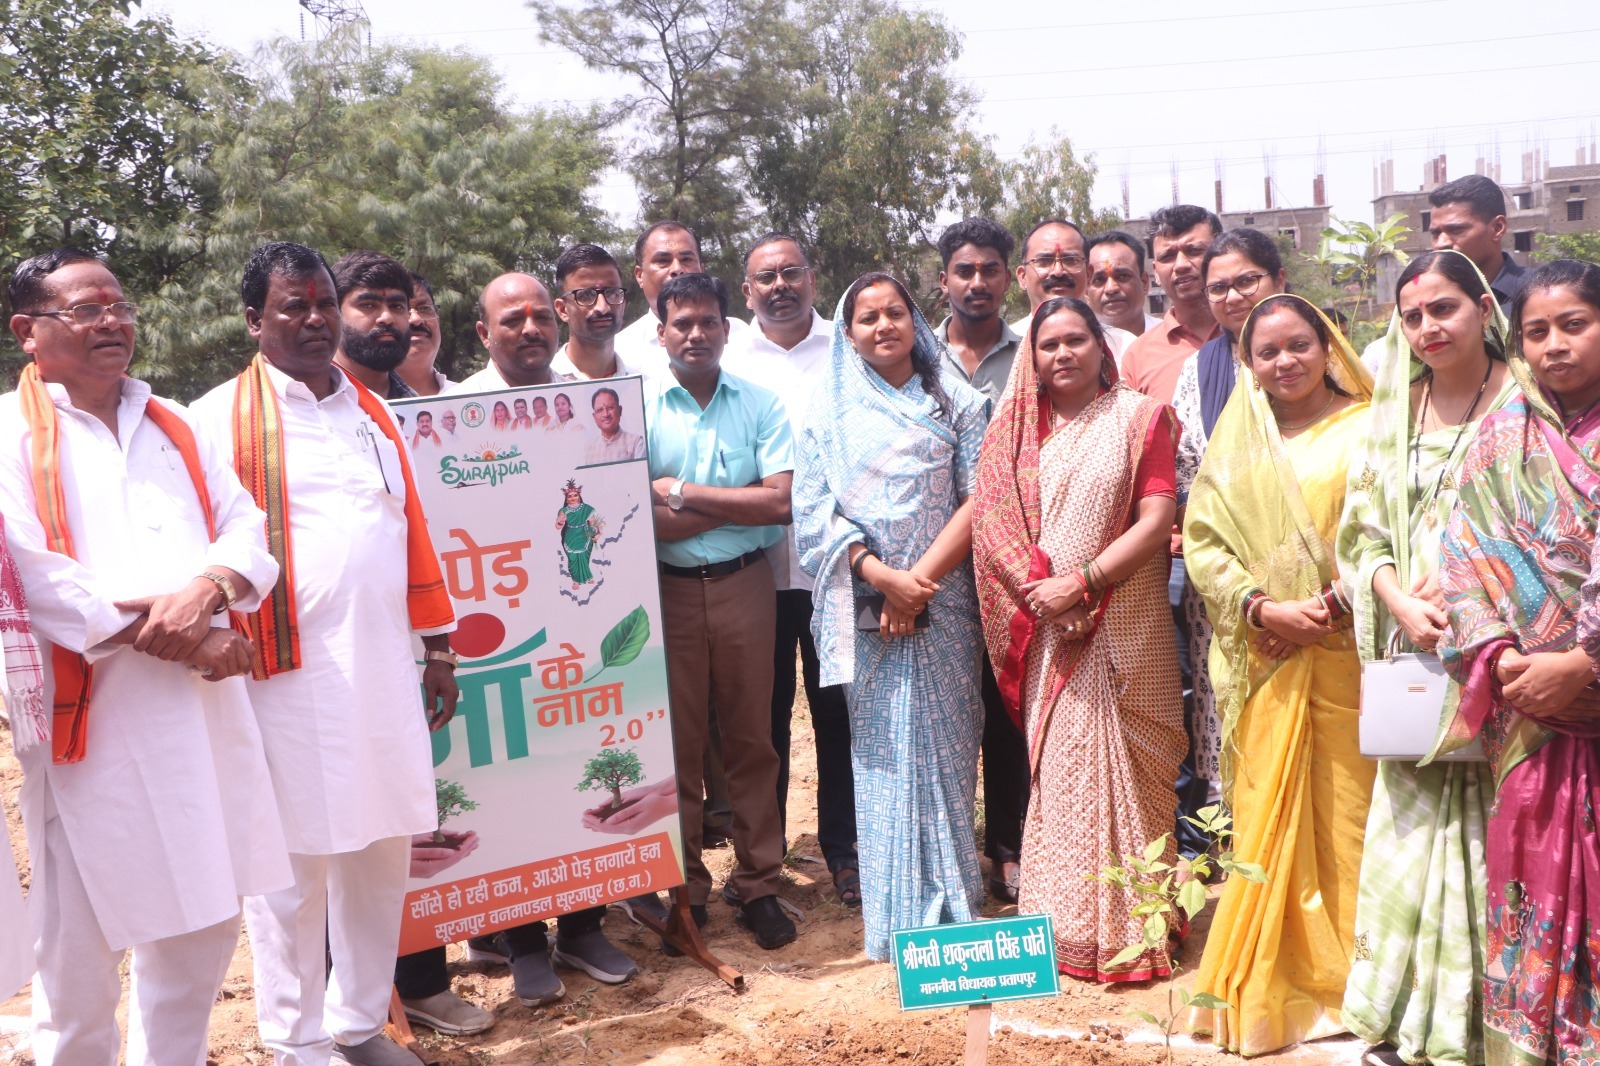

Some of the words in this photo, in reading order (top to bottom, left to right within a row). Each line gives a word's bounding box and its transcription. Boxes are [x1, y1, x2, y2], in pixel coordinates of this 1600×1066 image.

[440, 528, 531, 608] पेड़
[537, 642, 585, 690] के
[533, 681, 624, 727] नाम
[446, 885, 462, 910] हो
[465, 878, 489, 905] रही
[492, 875, 528, 898] कम,
[532, 860, 568, 887] आओ
[571, 855, 592, 879] पेड़
[594, 843, 636, 873] लगायें
[639, 842, 661, 863] हम
[434, 913, 486, 942] सूरजपुर
[488, 896, 553, 925] वनमण्डल
[556, 883, 604, 911] सूरजपुर
[607, 870, 652, 896] (छ.ग.)
[903, 939, 941, 970] श्रीमती
[942, 939, 995, 972] शकुन्तला
[995, 930, 1021, 960] सिंह
[919, 977, 957, 995] माननीय
[958, 976, 997, 991] विधायक
[998, 972, 1037, 988] प्रतापपुर
